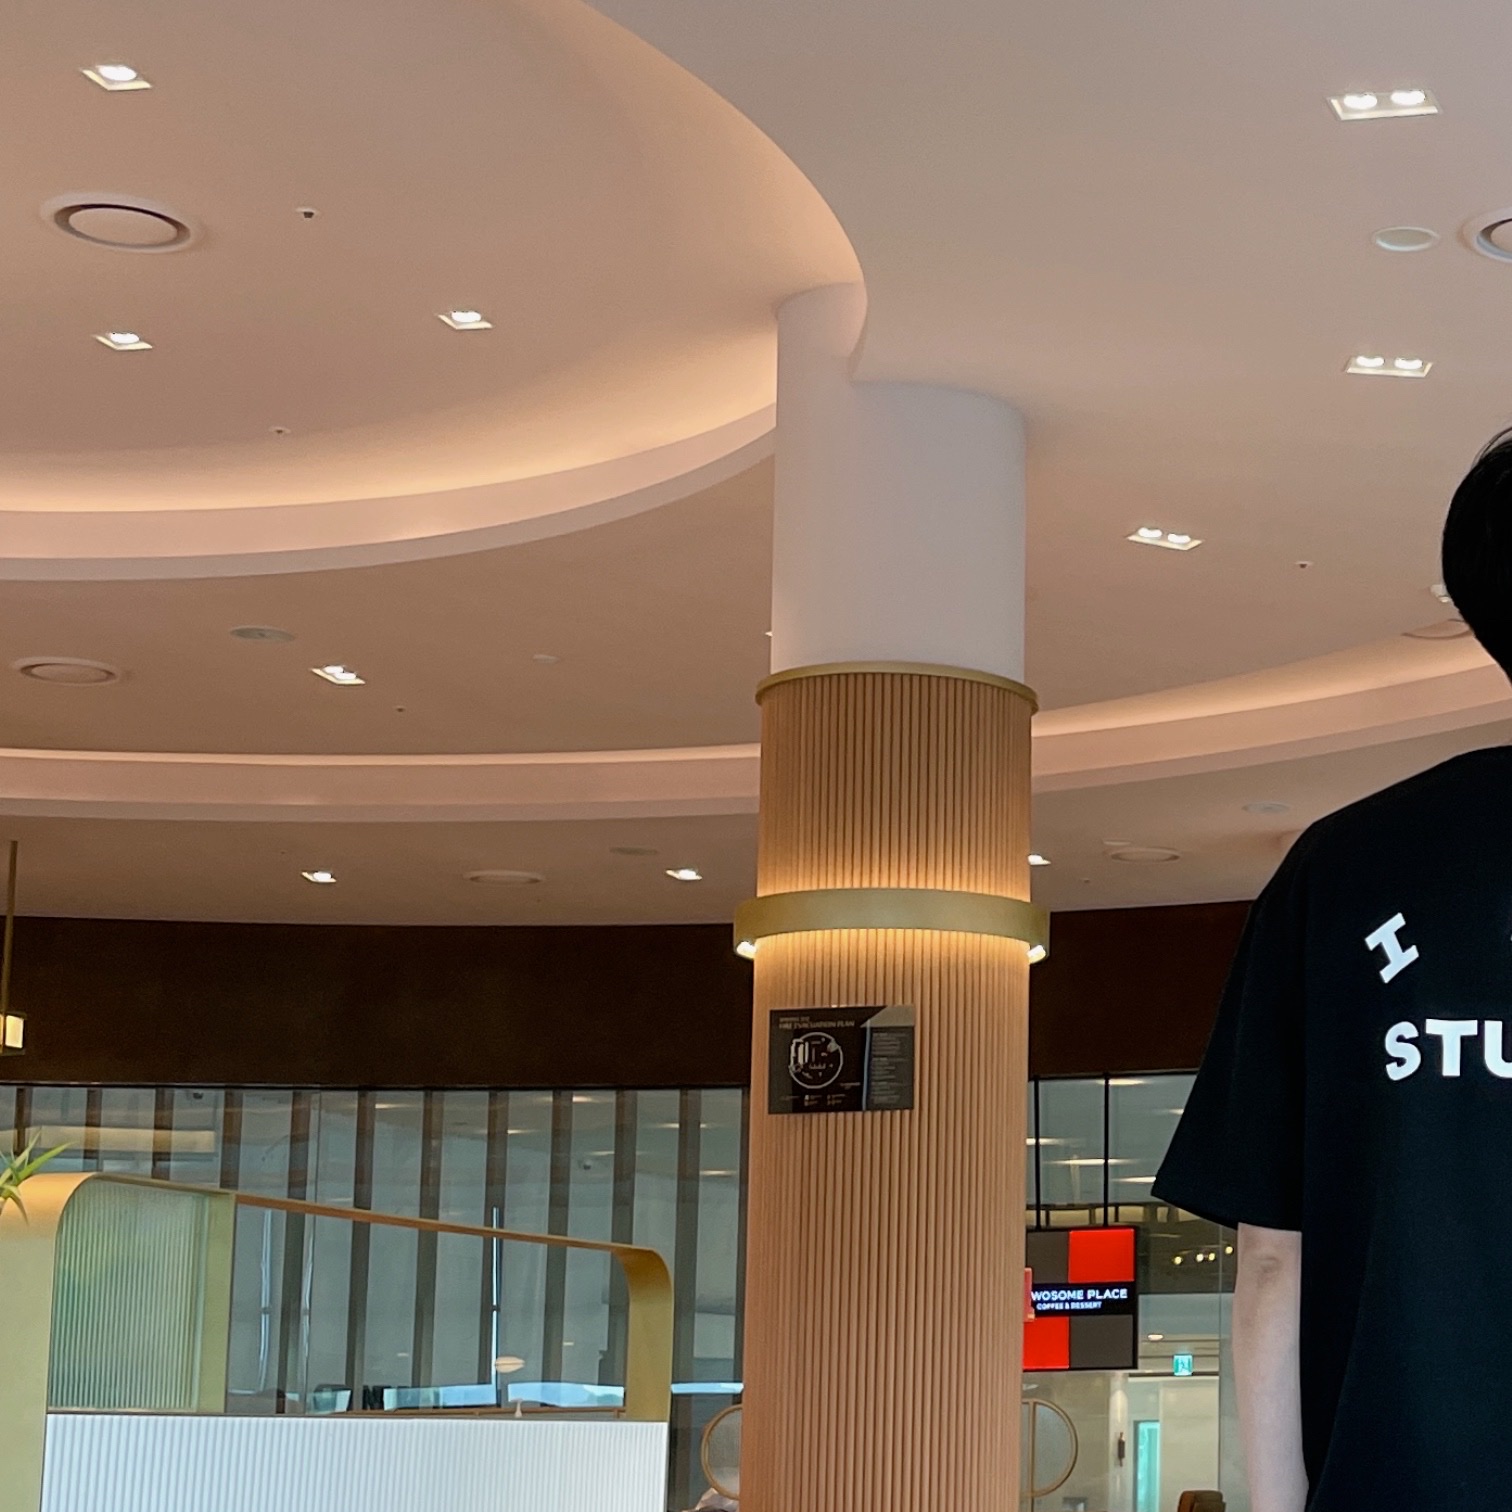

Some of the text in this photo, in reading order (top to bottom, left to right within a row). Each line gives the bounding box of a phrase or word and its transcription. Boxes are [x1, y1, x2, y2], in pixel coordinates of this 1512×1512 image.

[1030, 1288, 1128, 1301] WOSOME PLACE
[1036, 1301, 1064, 1310] COFFEE
[1070, 1301, 1102, 1310] DESSERT
